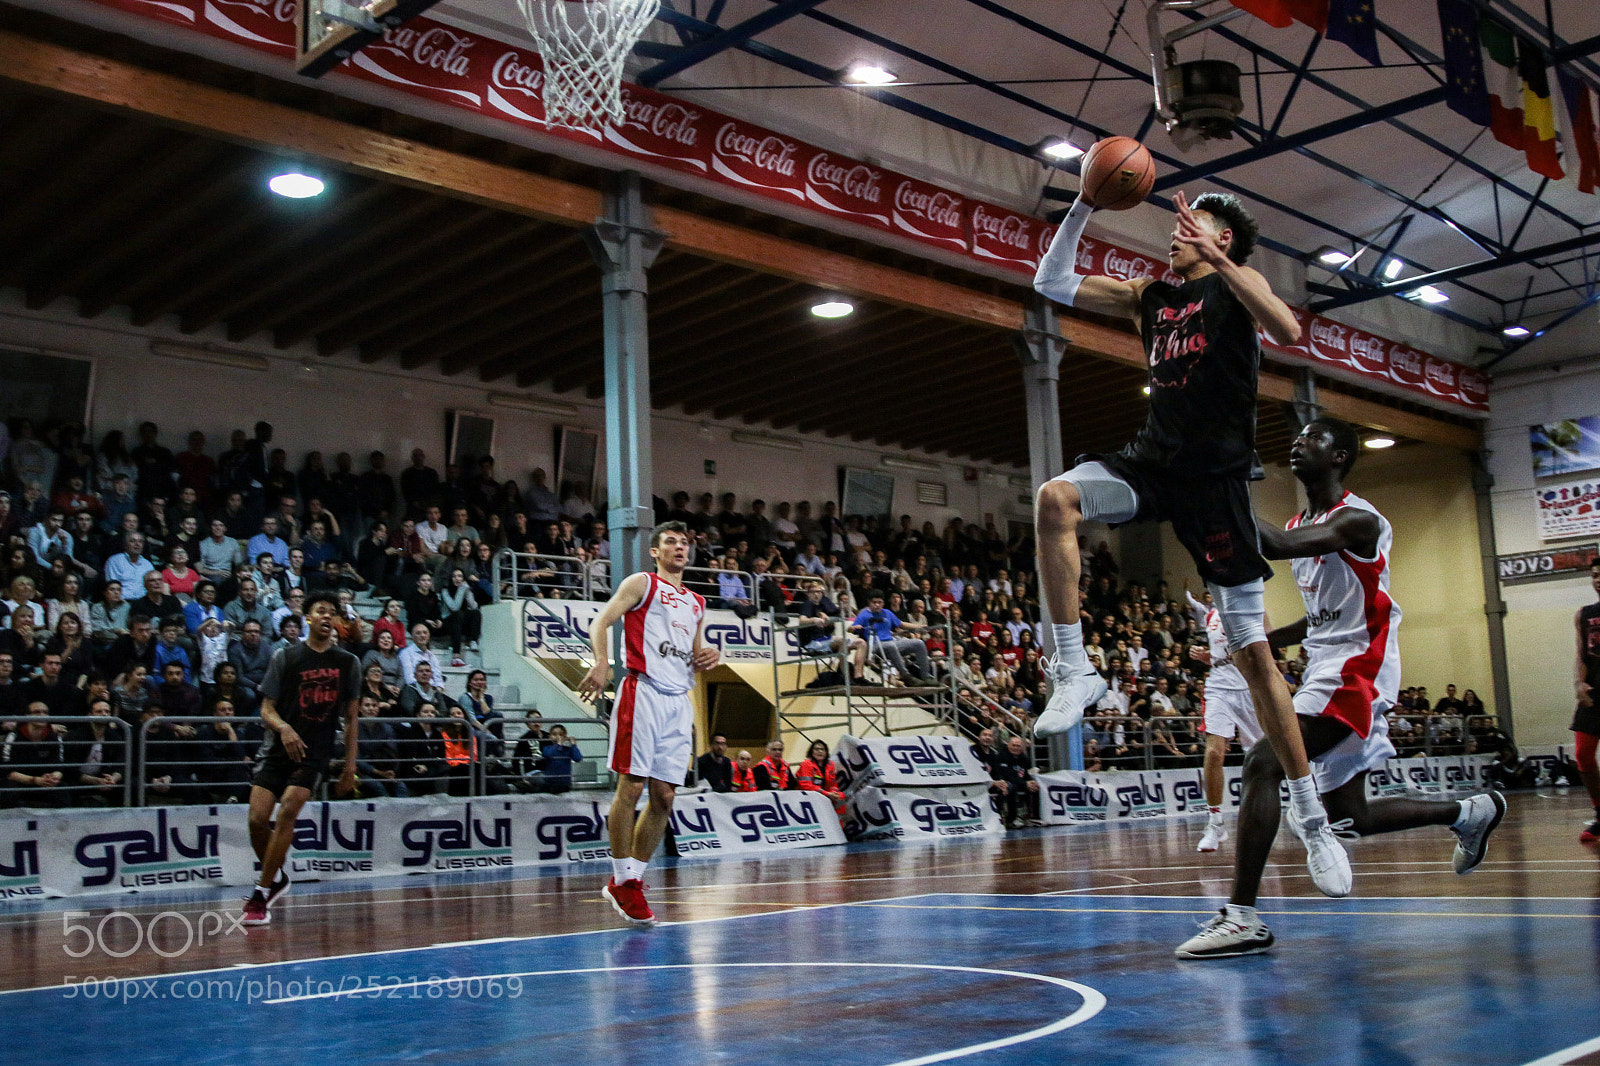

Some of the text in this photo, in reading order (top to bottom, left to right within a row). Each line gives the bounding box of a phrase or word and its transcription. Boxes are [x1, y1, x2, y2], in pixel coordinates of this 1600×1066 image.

[383, 27, 475, 78] ca-Cola
[715, 122, 797, 177] Coca-Cola
[807, 152, 882, 203] Coca-Cola
[894, 180, 960, 228] Coca-Cola
[973, 205, 1030, 250] Coca-Cola
[546, 645, 593, 653] LISSON
[724, 650, 772, 659] LISSONE
[299, 668, 340, 681] TEAM
[917, 769, 969, 778] LISSONE
[1174, 769, 1203, 811] gal
[269, 802, 375, 866] alvi
[402, 802, 512, 867] galvi
[537, 801, 604, 861] gal
[731, 790, 819, 843] galvi
[766, 829, 826, 846] LISSONE
[75, 806, 220, 887] galvi
[435, 856, 513, 870] LISSONE
[567, 849, 612, 862] LISS
[677, 839, 722, 853] SONE
[119, 866, 224, 888] LISSONE
